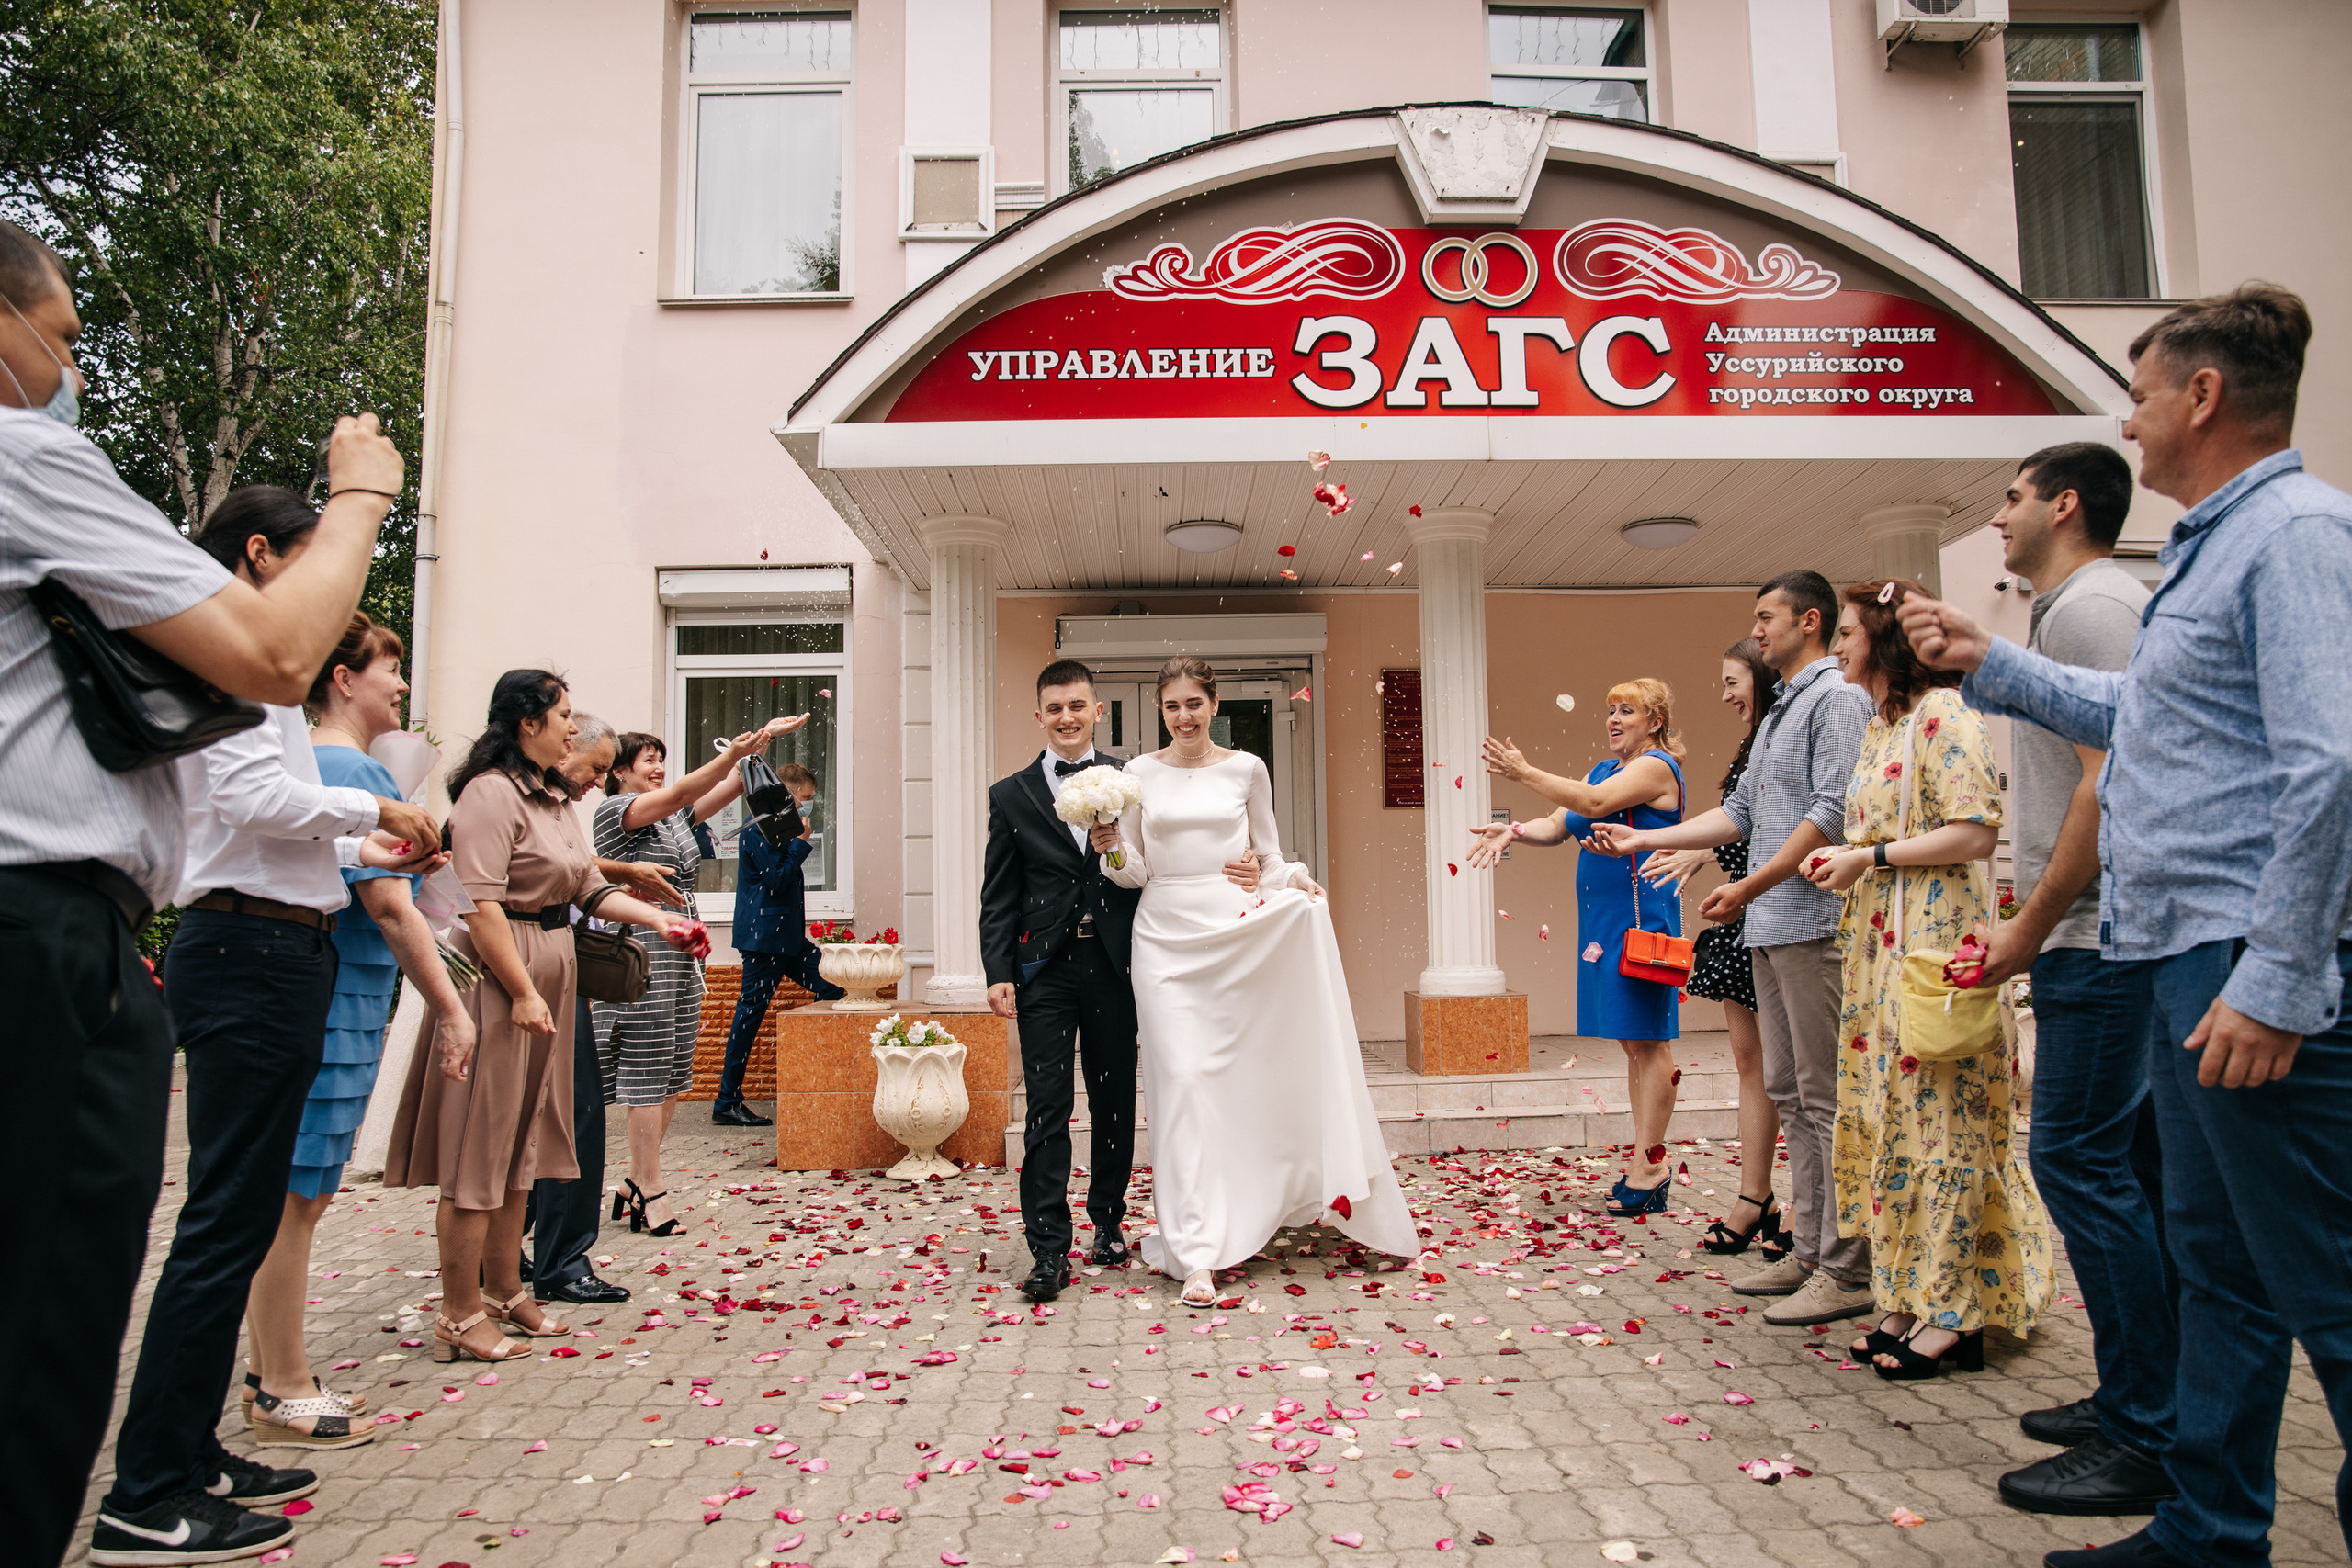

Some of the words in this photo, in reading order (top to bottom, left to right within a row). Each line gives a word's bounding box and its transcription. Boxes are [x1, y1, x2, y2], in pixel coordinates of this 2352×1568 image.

[1704, 321, 1936, 348] Администрация
[967, 348, 1276, 381] УПРАВЛЕНИЕ
[1291, 314, 1678, 408] ЗАГС
[1705, 351, 1905, 378] Уссурийского
[1709, 388, 1870, 409] городского
[1878, 388, 1974, 409] округа
